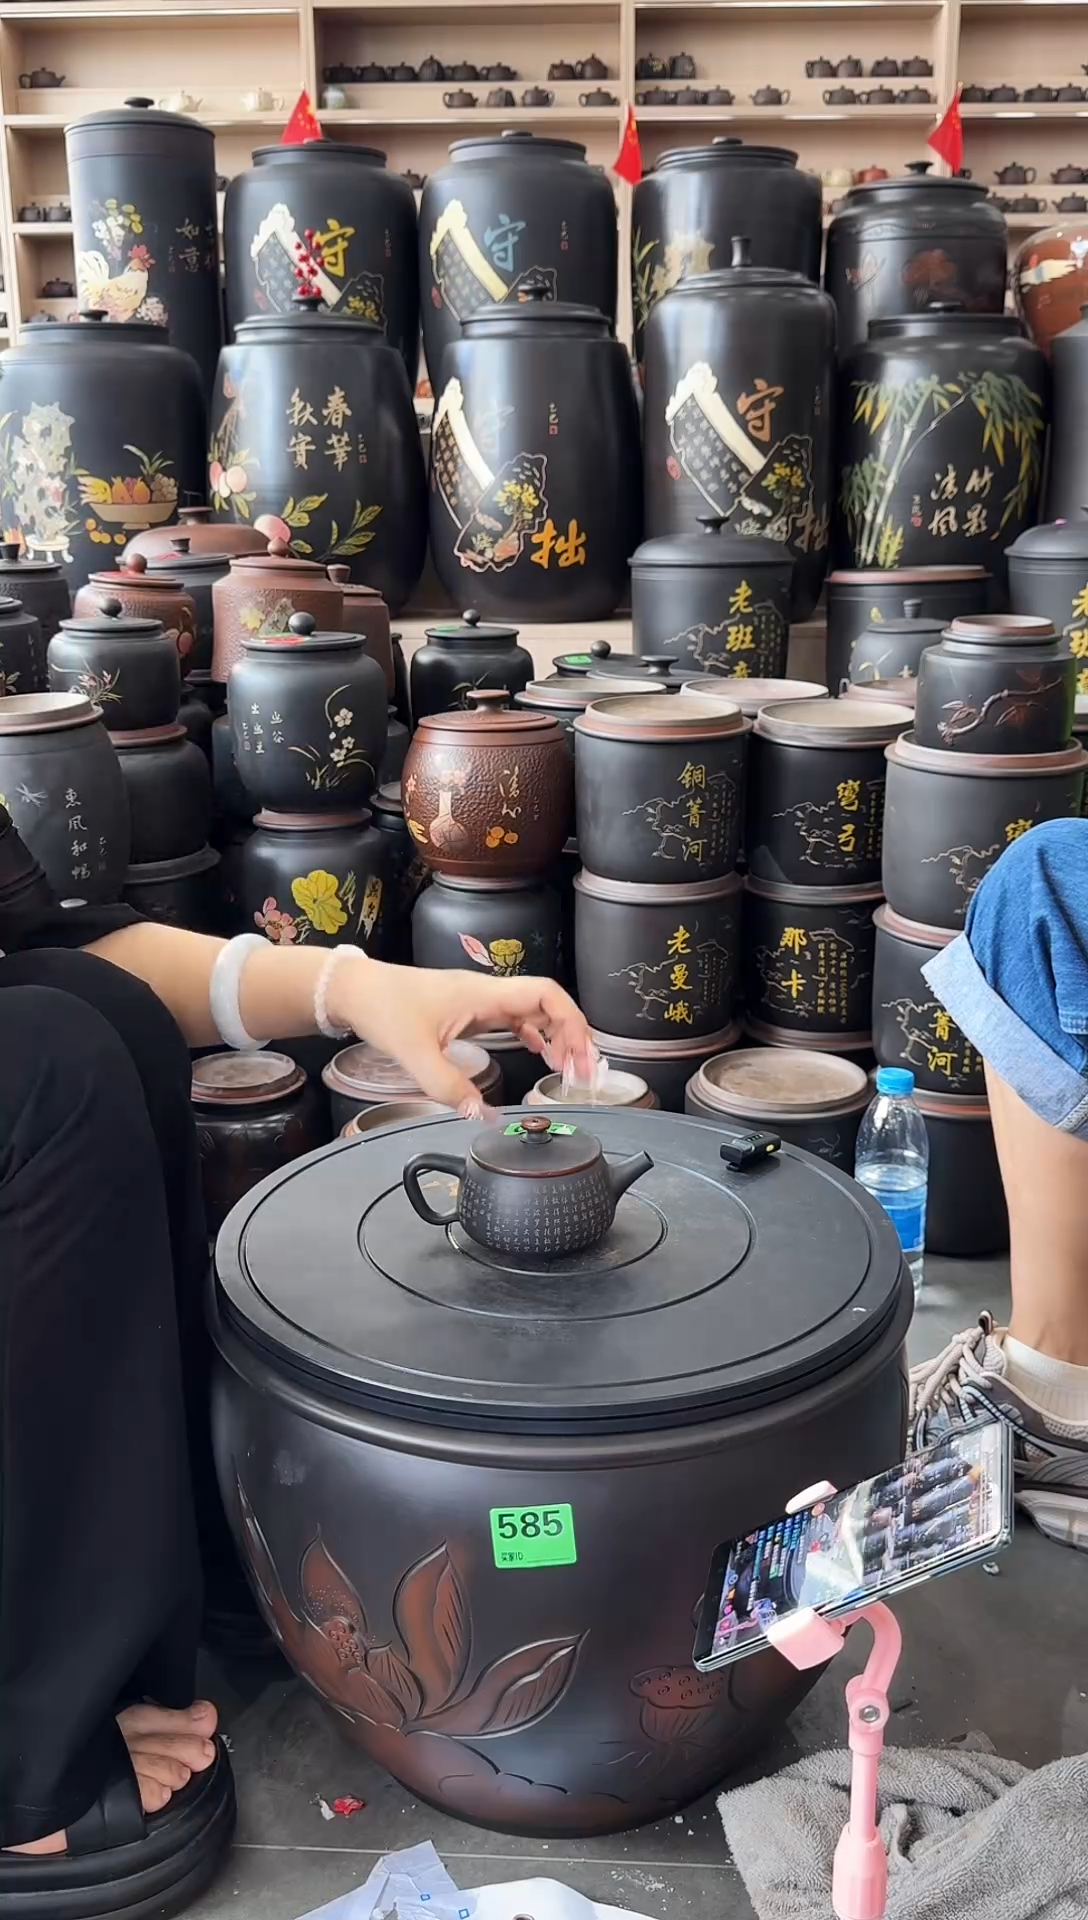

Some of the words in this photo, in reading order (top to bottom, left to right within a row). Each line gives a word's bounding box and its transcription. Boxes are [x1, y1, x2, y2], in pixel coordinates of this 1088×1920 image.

[313, 218, 355, 277] 守
[484, 213, 526, 272] 守
[737, 378, 784, 442] 守
[531, 518, 587, 569] 拙
[780, 927, 808, 999] 那卡
[498, 1510, 563, 1539] 585
